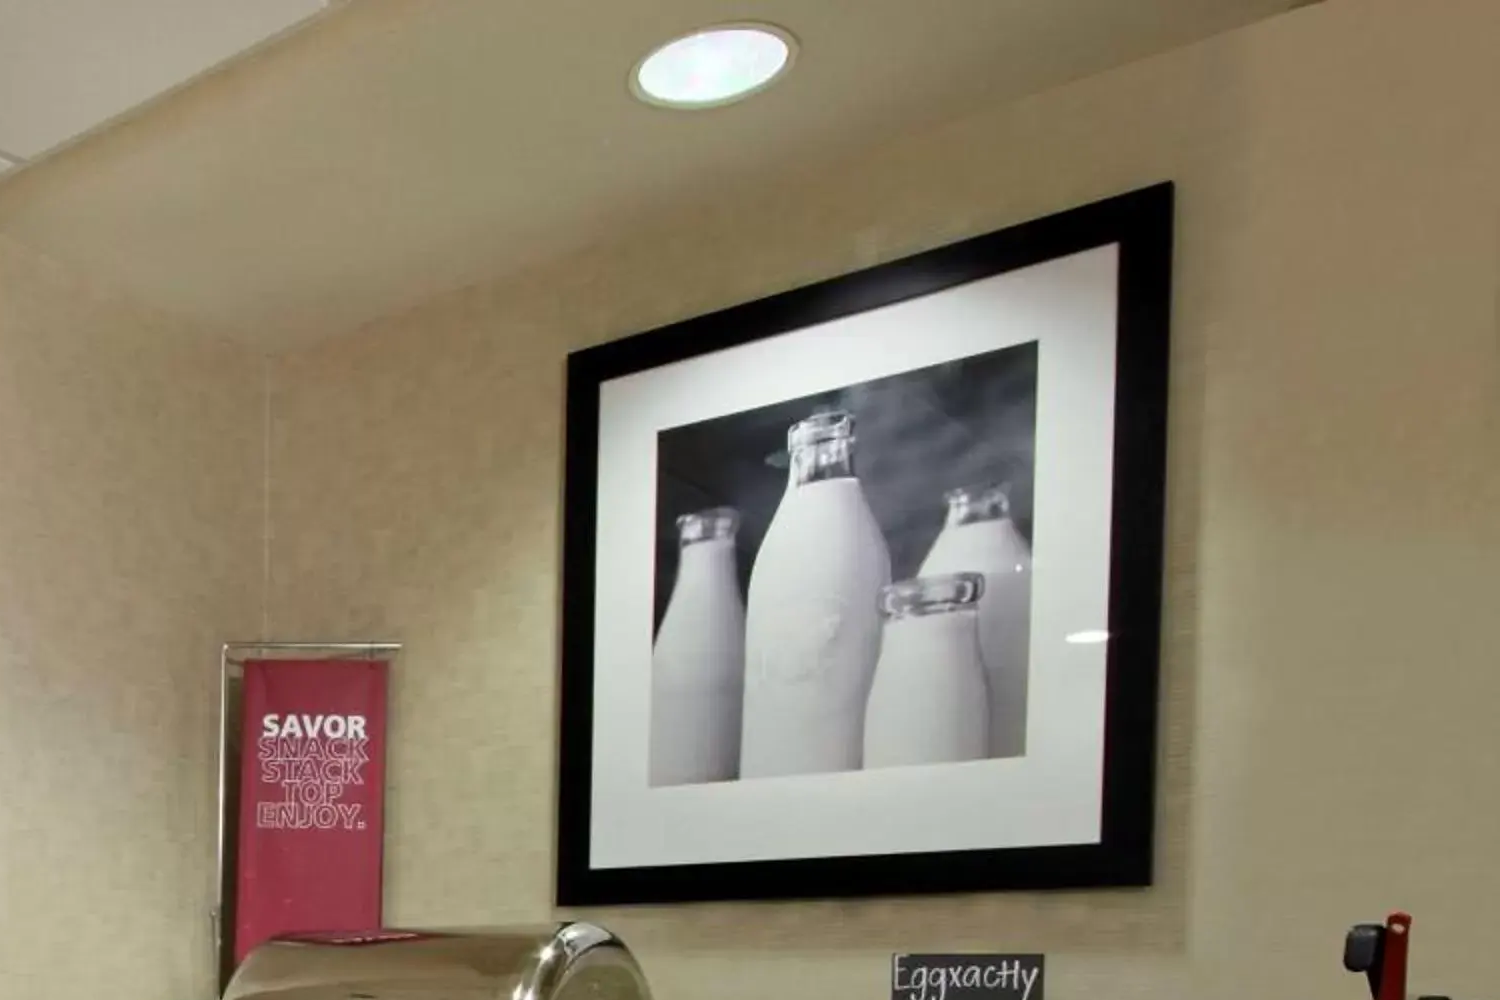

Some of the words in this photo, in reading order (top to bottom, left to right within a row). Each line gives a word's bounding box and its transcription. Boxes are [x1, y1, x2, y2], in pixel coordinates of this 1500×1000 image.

[262, 714, 366, 738] SAVOR
[258, 736, 368, 760] SNACK
[260, 758, 363, 784] STACK
[281, 780, 342, 805] TOP
[257, 801, 366, 829] ENJOY.
